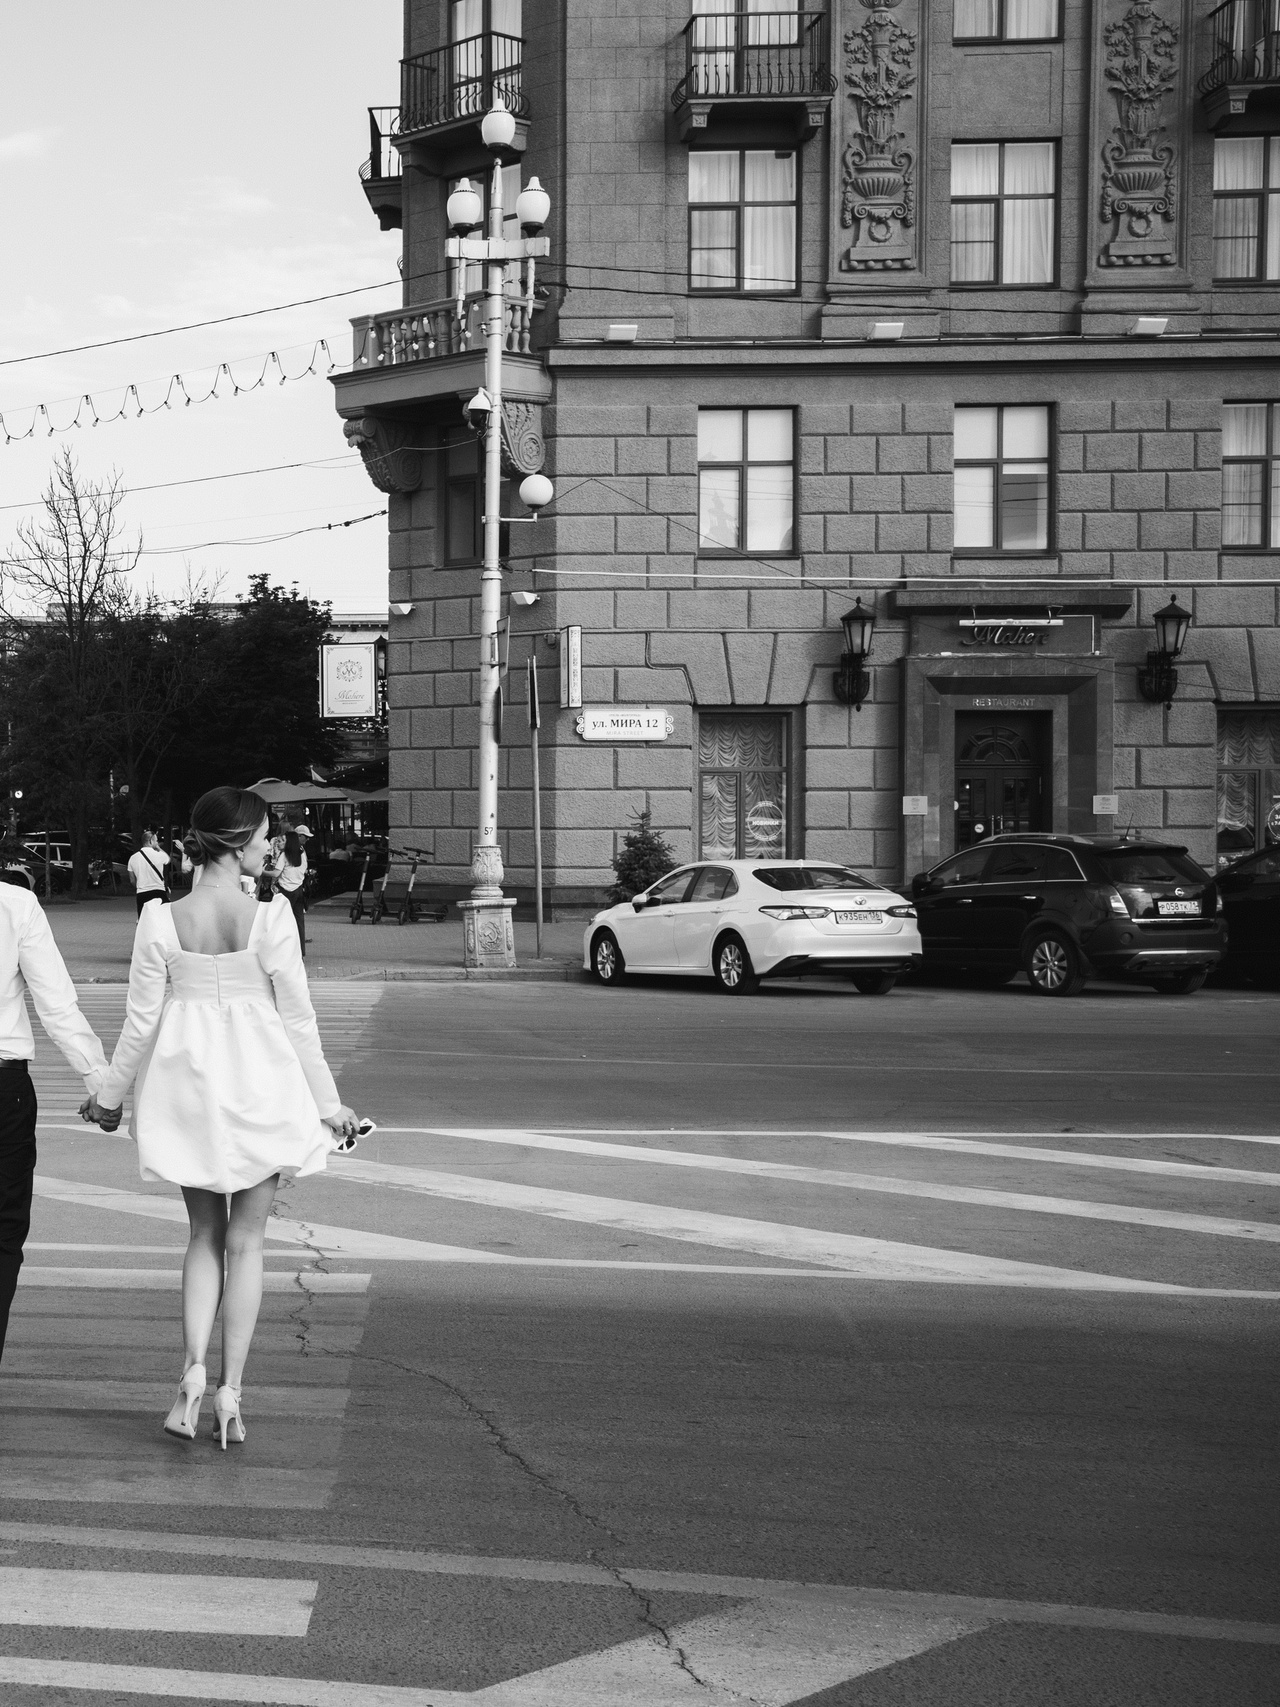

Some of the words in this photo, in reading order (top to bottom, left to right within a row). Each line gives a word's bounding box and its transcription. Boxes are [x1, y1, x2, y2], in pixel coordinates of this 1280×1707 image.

[972, 698, 1036, 707] RESTAURANT
[592, 720, 608, 731] ул.
[610, 719, 642, 728] МИРА
[646, 719, 659, 728] 12
